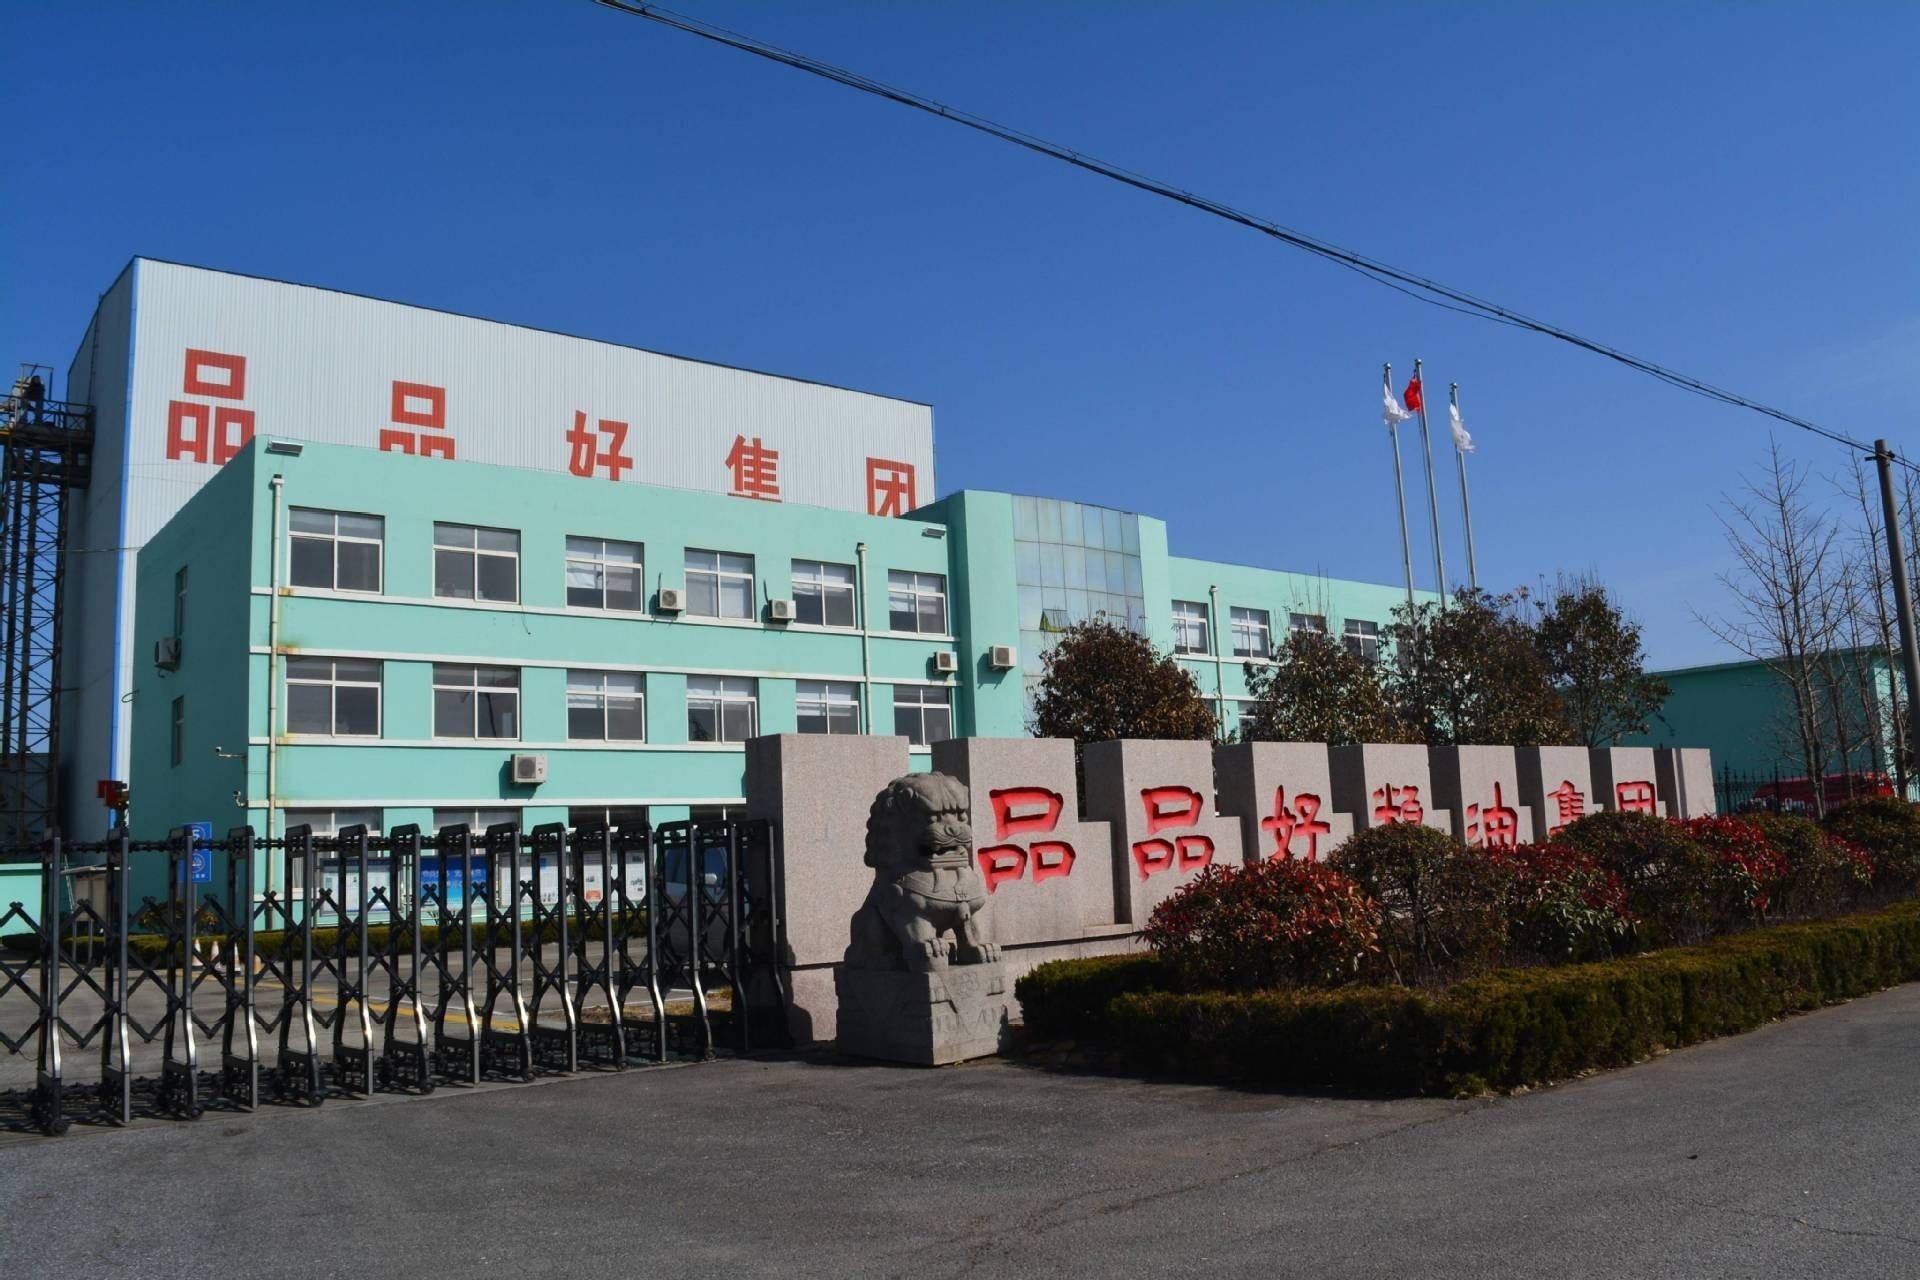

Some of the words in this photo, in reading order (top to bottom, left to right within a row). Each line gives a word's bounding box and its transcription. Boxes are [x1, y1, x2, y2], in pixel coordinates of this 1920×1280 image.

[166, 349, 918, 516] 品品好集团
